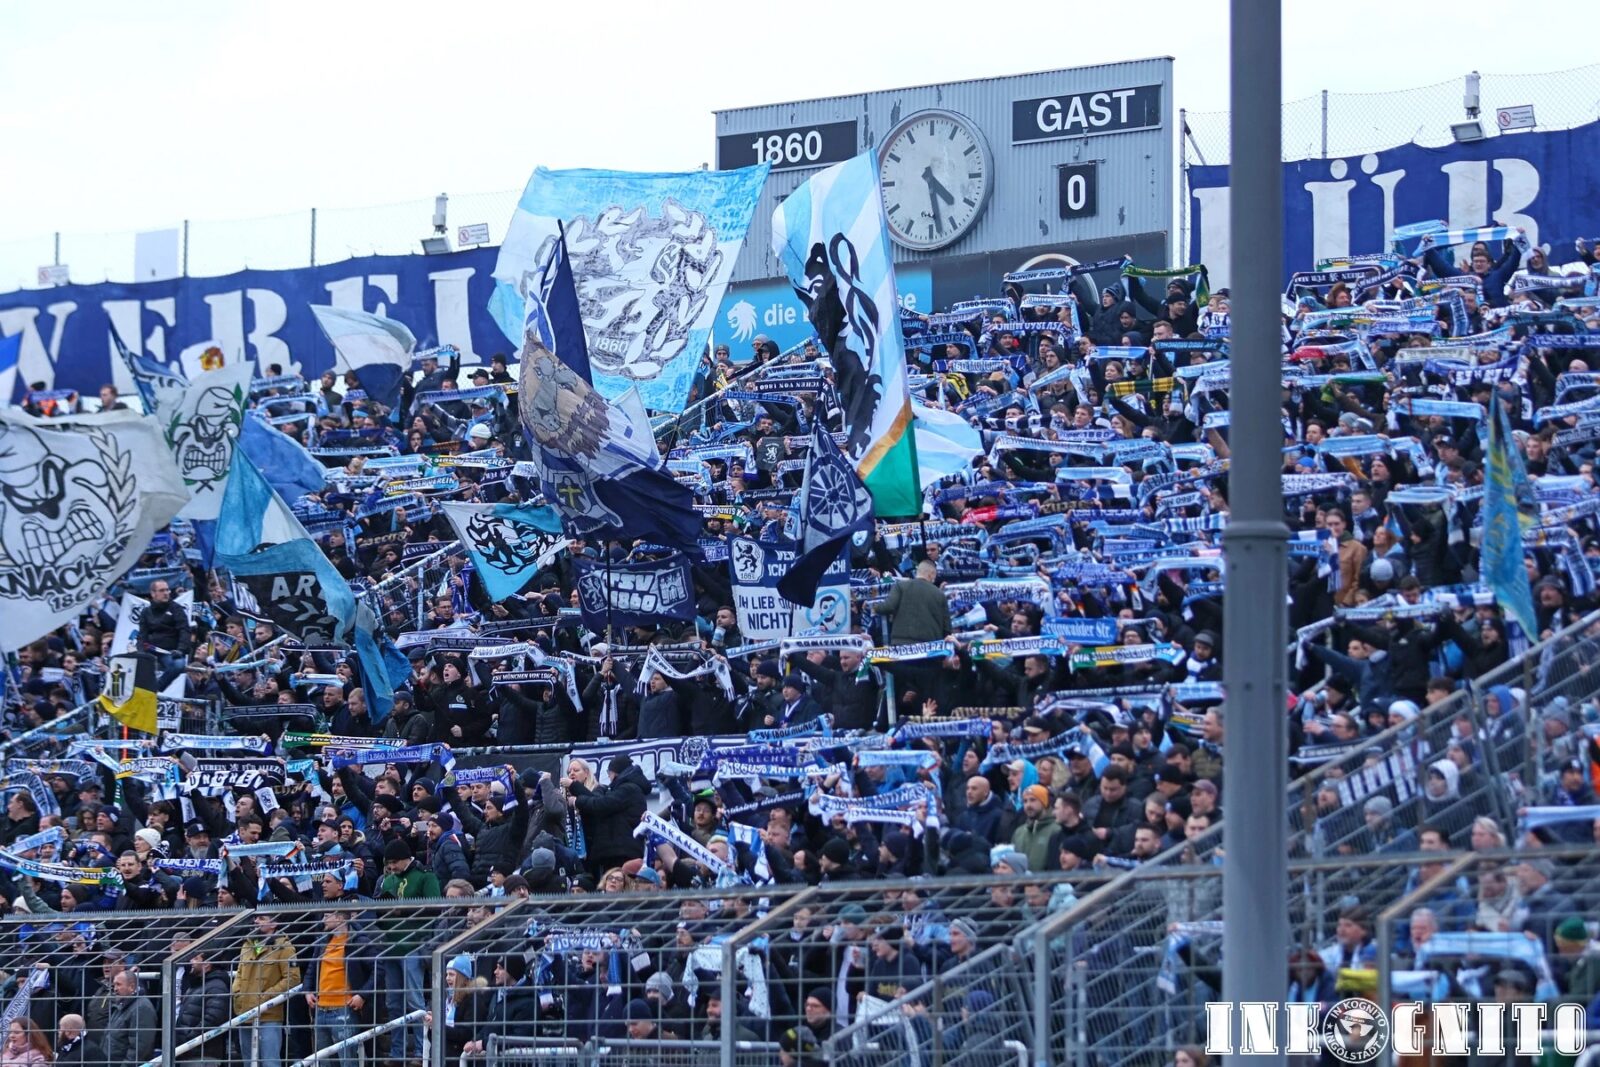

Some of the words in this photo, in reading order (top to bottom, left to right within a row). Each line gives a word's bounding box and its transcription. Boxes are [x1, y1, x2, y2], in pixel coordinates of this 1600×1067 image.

[1036, 89, 1136, 133] GAST
[752, 130, 823, 165] 1860
[1067, 175, 1086, 210] 0
[764, 304, 796, 326] die
[594, 338, 630, 353] 1860
[768, 563, 787, 577] ICH
[601, 571, 655, 592] TSV
[608, 590, 657, 612] 1860
[751, 595, 777, 610] LIEB
[867, 650, 889, 659] SIND
[901, 645, 919, 655] DER
[979, 643, 1001, 654] SIND
[1012, 640, 1032, 650] DER
[502, 673, 528, 681] MÜNCHEN
[386, 749, 421, 760] MÜNCHEN
[750, 756, 793, 764] RECHTS
[158, 859, 200, 868] MÜNCHEN
[304, 859, 347, 871] MÜNCHEN
